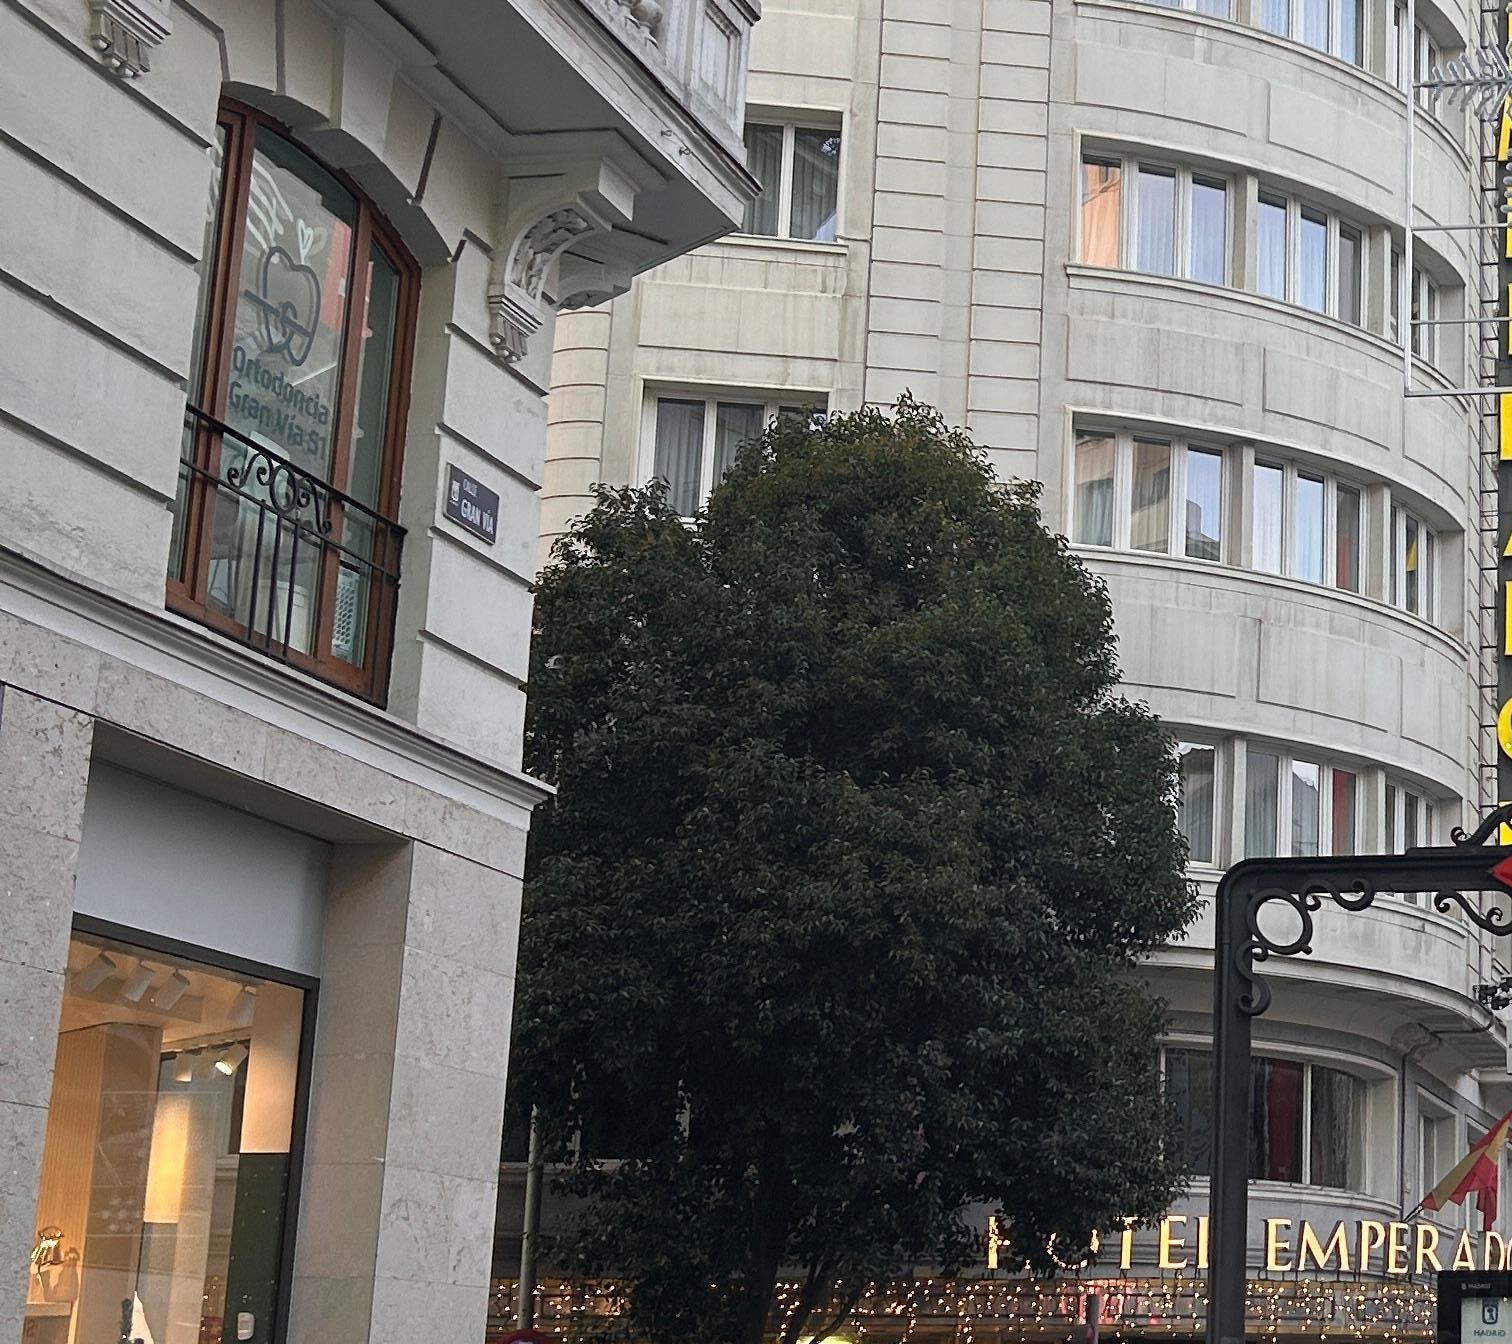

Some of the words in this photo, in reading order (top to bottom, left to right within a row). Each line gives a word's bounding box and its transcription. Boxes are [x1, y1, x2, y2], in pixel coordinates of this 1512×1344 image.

[229, 380, 270, 427] Gran
[232, 345, 331, 425] Ortodoncia
[461, 499, 480, 526] GRAN
[1473, 1329, 1506, 1337] MADRID
